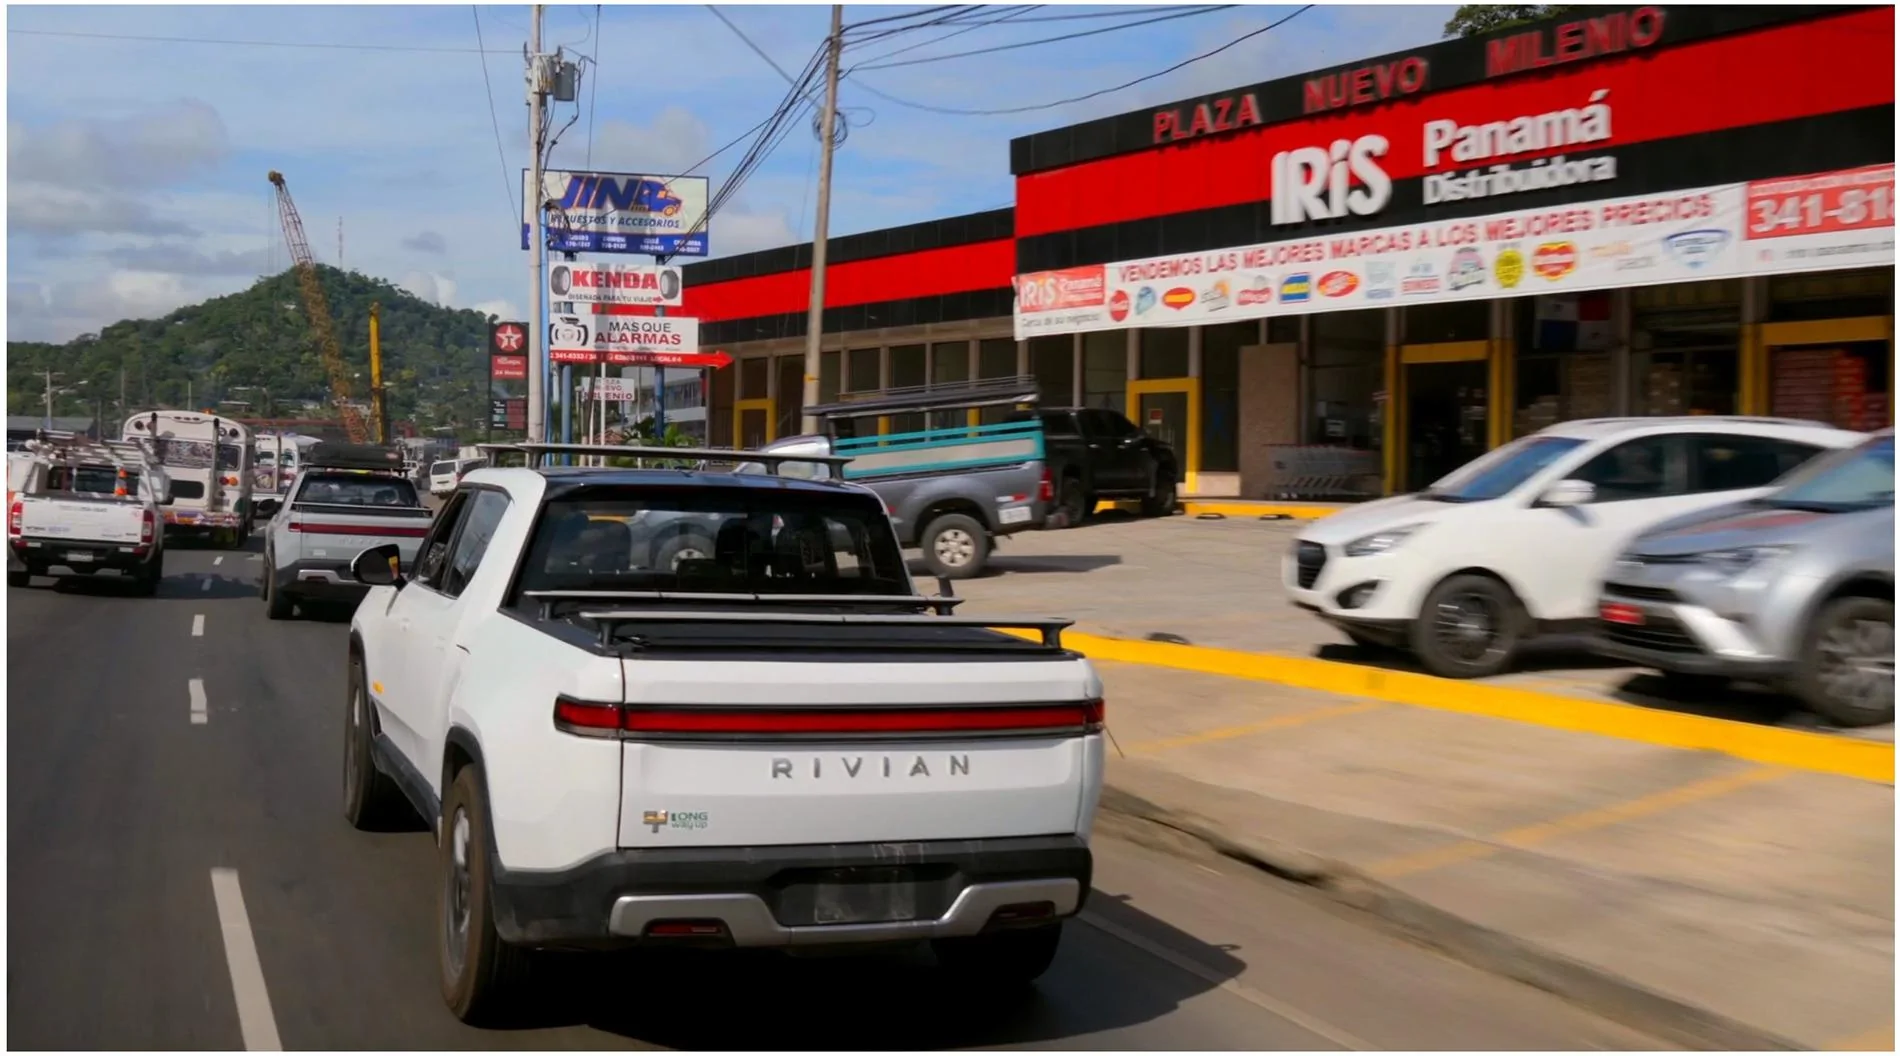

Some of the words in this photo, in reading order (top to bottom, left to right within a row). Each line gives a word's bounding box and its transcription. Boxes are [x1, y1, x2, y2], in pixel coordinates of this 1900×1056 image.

[1153, 93, 1263, 144] PLAZA
[1303, 57, 1429, 115] NUEVO
[1486, 6, 1667, 78] MILENIO
[1422, 89, 1613, 168] Panamá
[1422, 155, 1618, 205] Distribuidora
[609, 216, 617, 225] Y
[617, 216, 681, 229] ACCESORIOS
[1750, 186, 1895, 233] 341-81
[1119, 258, 1202, 282] VENDEMOS
[1207, 253, 1238, 273] LAS
[1243, 242, 1324, 269] MEJORES
[1330, 231, 1411, 259] MARCAS
[1418, 229, 1430, 247] A
[1437, 223, 1477, 246] LOS
[1484, 209, 1593, 241] MEJORES
[1602, 193, 1714, 225] PRECIOS
[572, 270, 659, 290] KENDA
[594, 332, 682, 346] ALARMAS
[642, 322, 671, 333] QUE
[771, 754, 970, 779] RIVIAN
